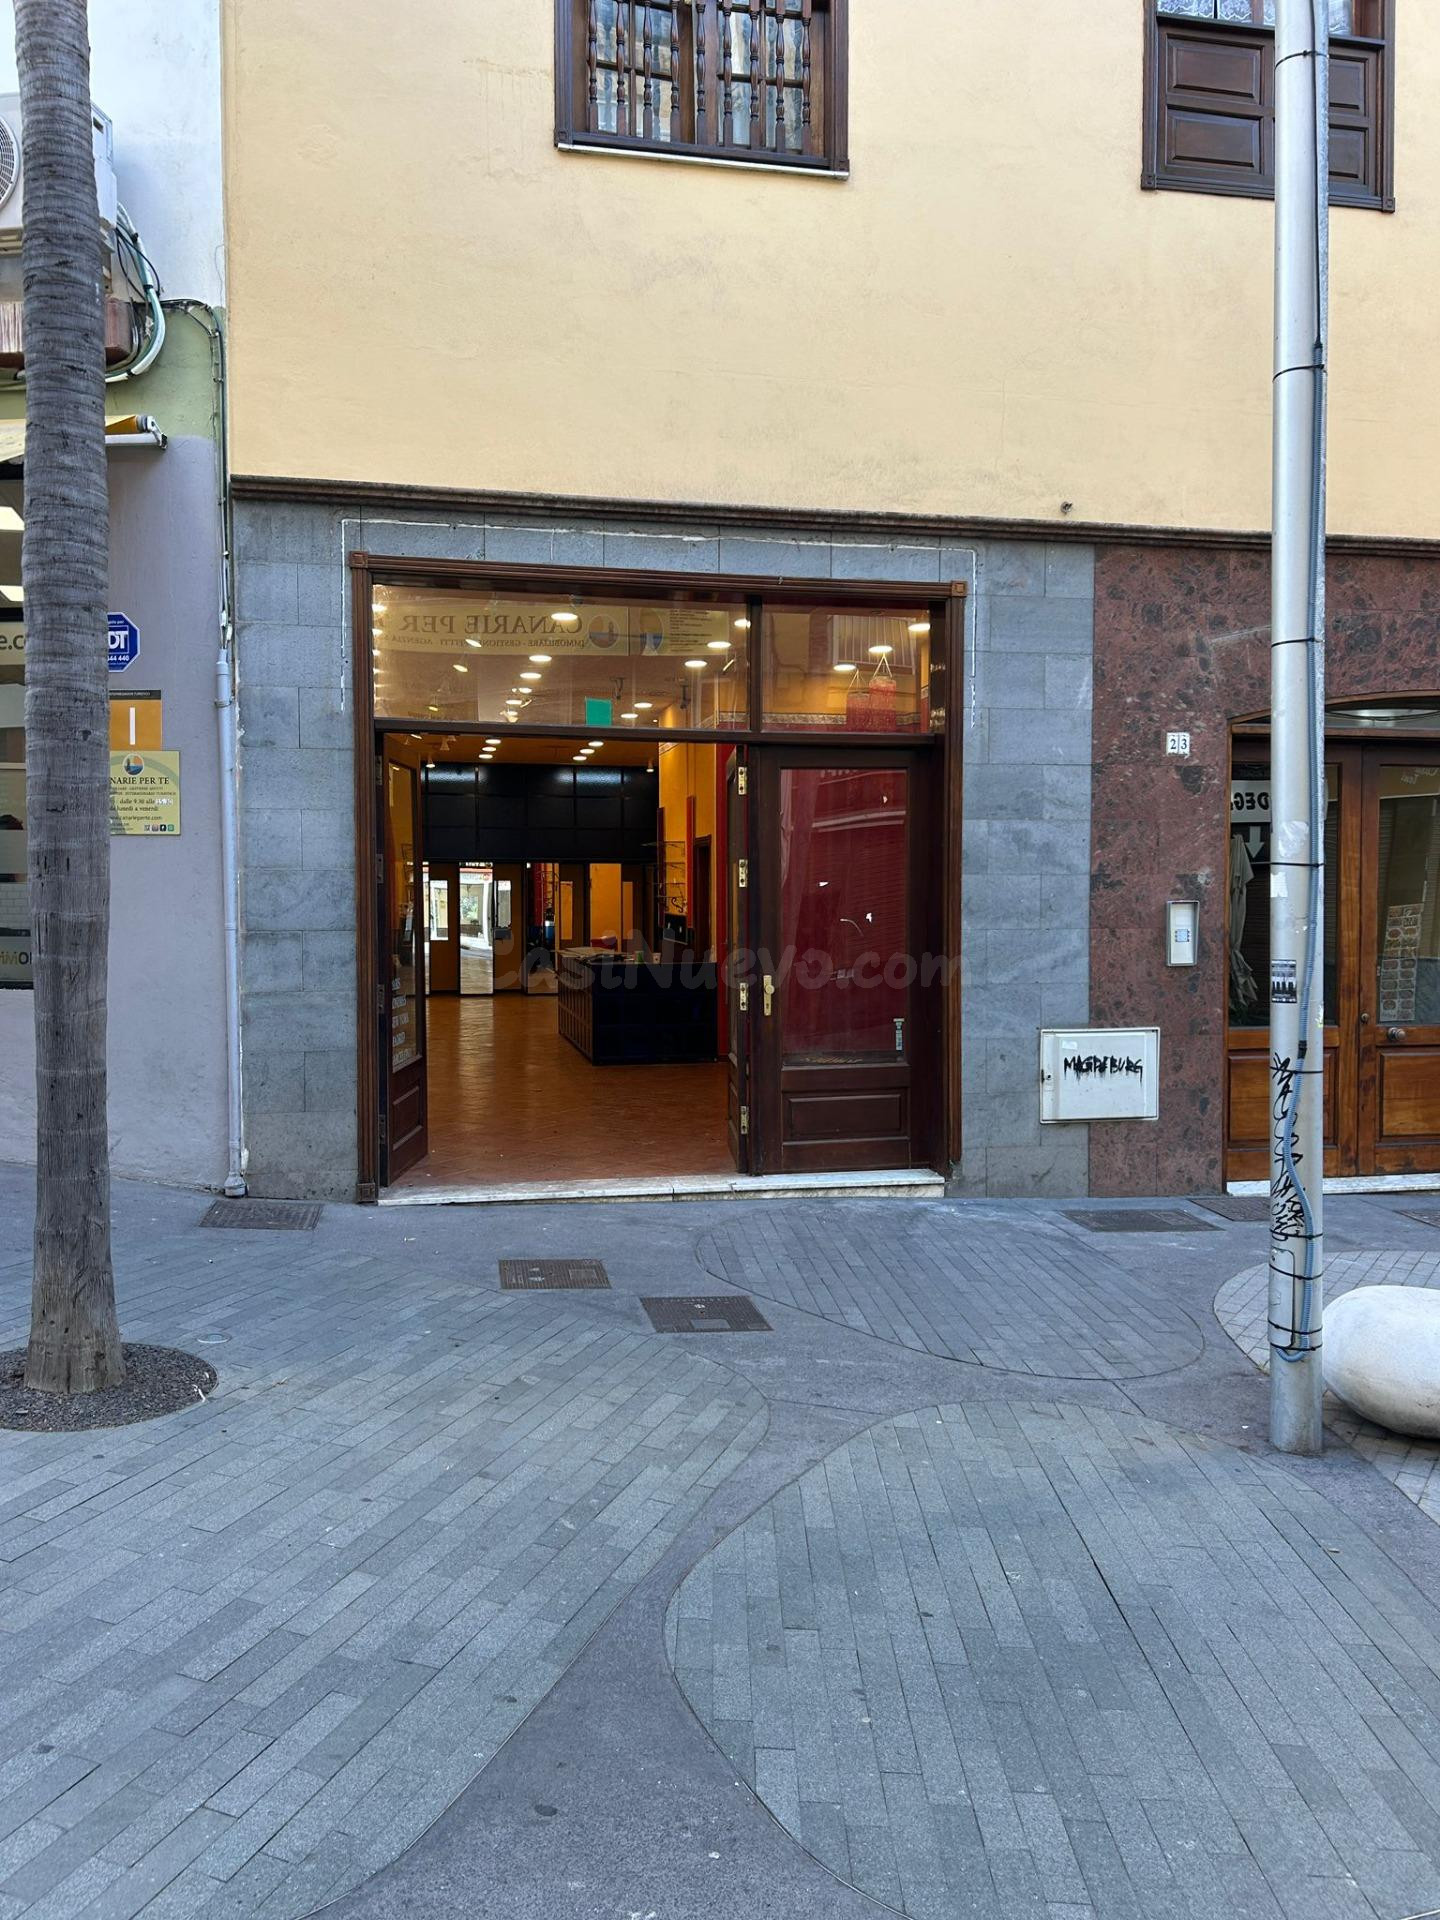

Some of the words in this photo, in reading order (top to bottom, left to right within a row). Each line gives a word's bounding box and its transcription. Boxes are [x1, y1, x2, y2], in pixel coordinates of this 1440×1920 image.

[108, 630, 129, 649] DT
[109, 777, 137, 785] NARIE
[139, 777, 158, 785] PER
[159, 777, 170, 785] TE
